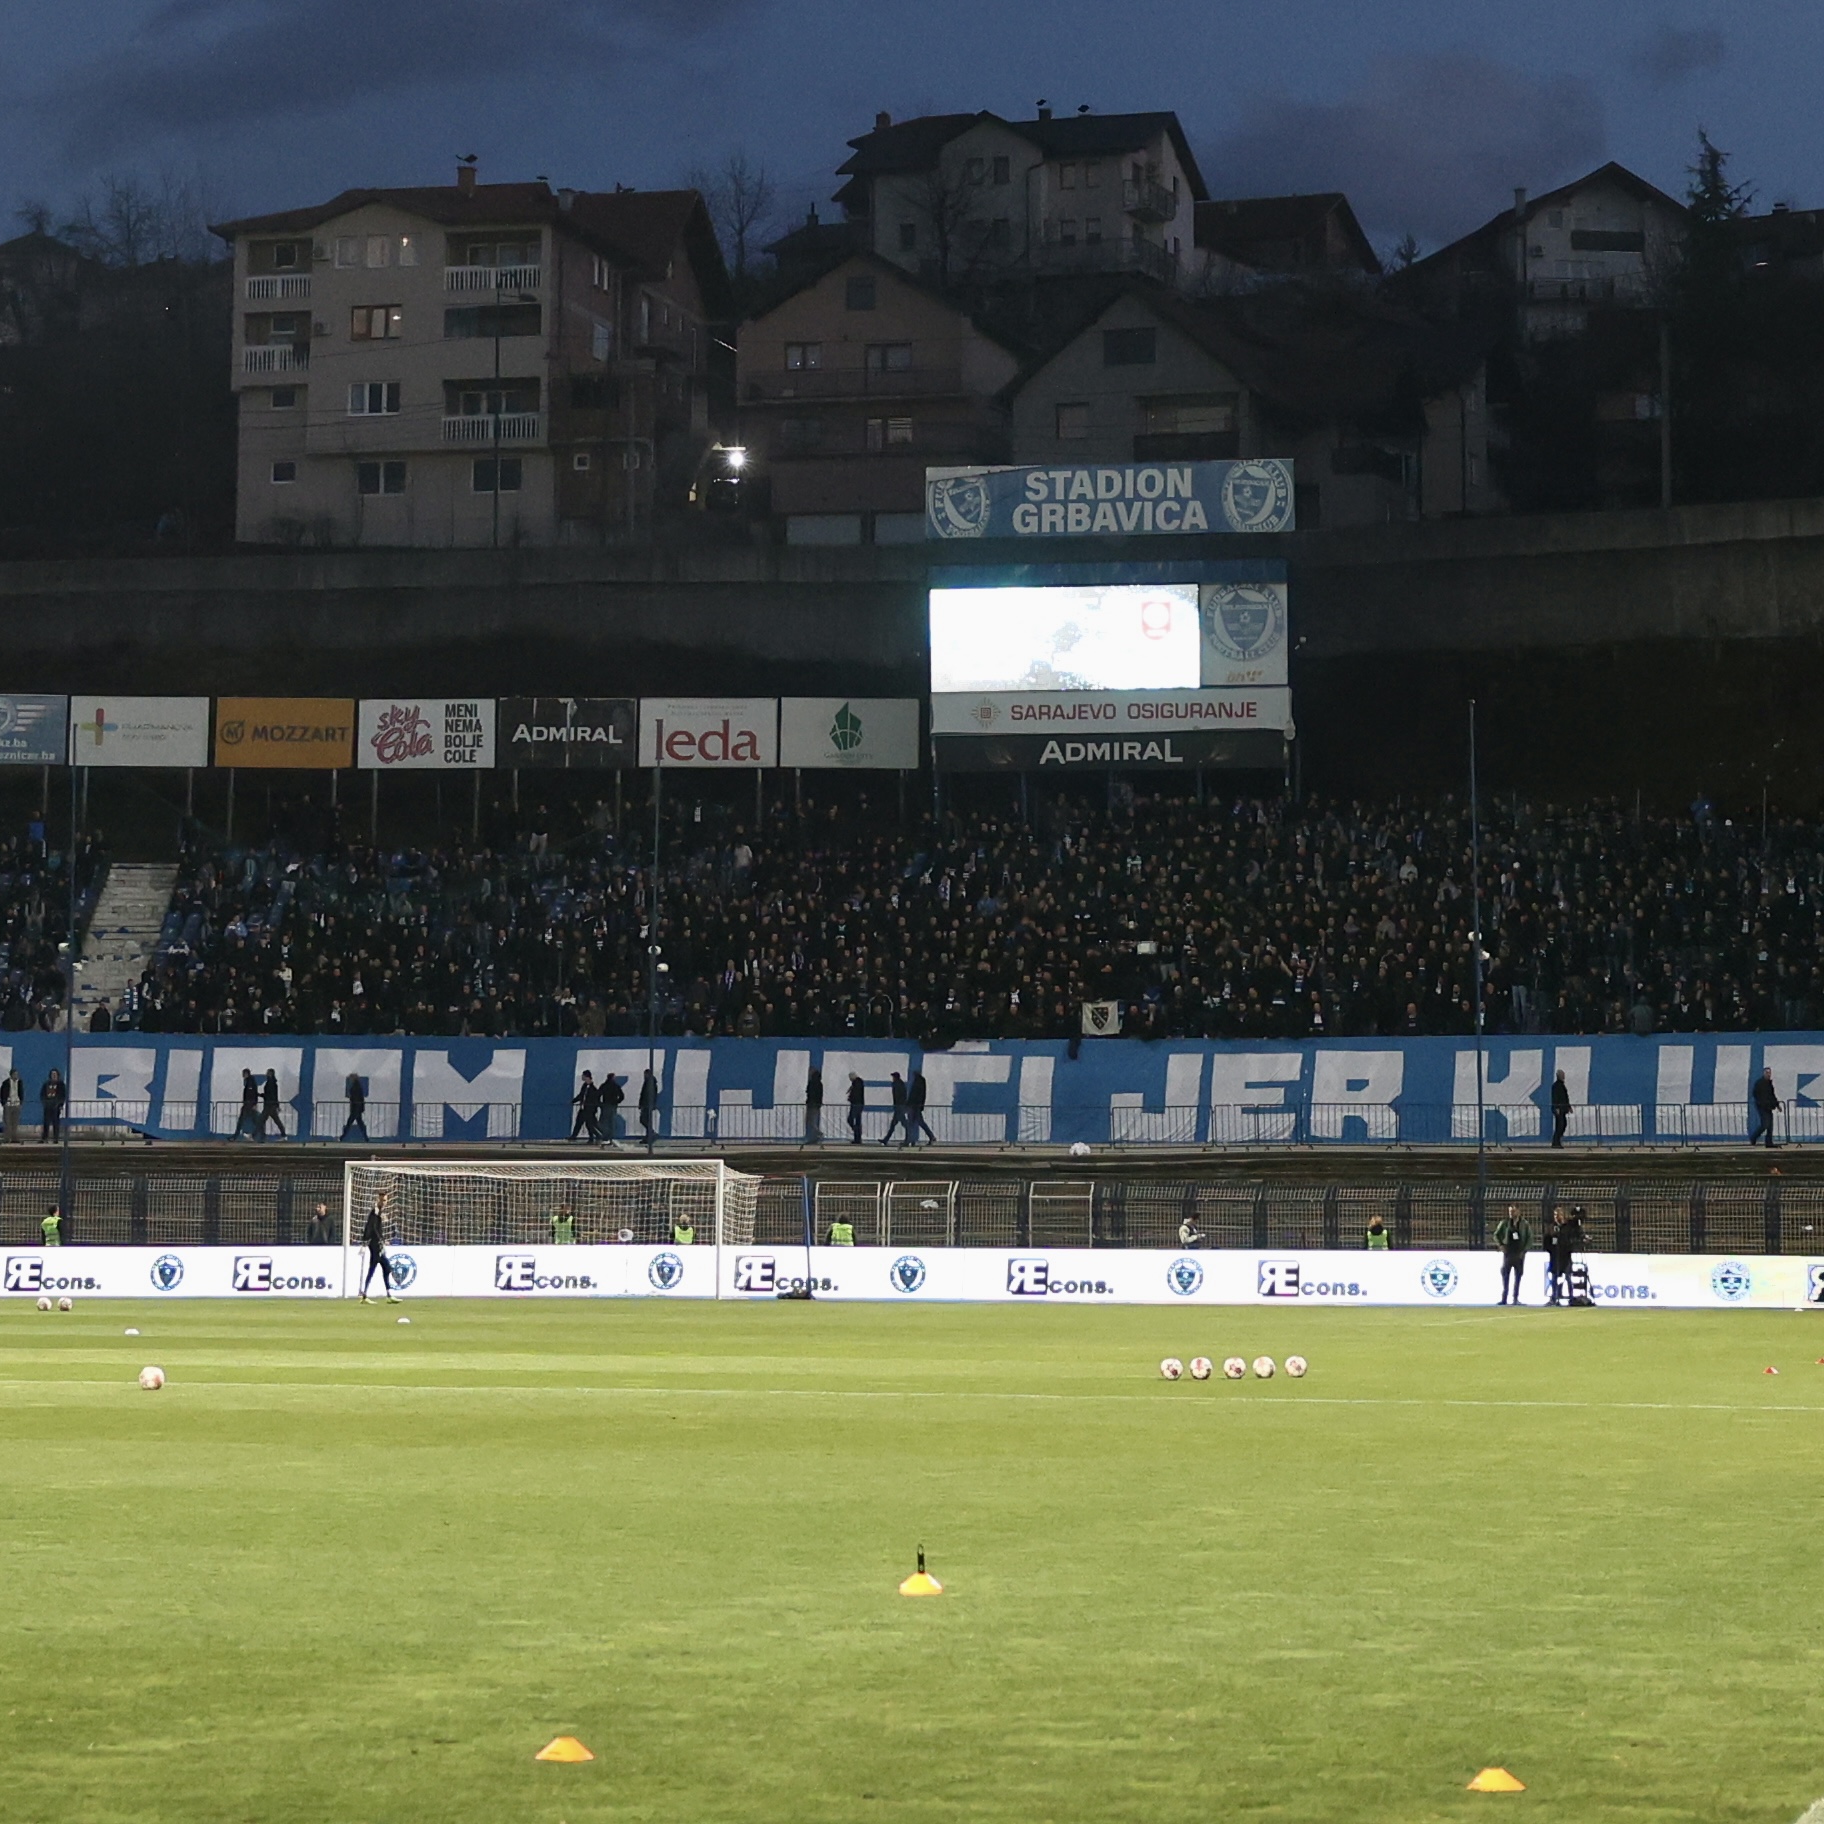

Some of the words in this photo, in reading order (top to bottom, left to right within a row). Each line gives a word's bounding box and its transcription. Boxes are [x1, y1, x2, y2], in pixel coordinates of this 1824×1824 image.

[1025, 468, 1193, 501] STADION
[1012, 500, 1208, 534] GRBAVICA
[377, 704, 431, 734] sky
[445, 704, 478, 718] MENI
[1011, 704, 1117, 721] SARAJEVO
[1127, 702, 1257, 719] OSIGURANJE
[251, 726, 350, 743] MOZZART
[445, 719, 483, 733] NEMA
[511, 723, 624, 744] ADMIRAL
[371, 727, 435, 765] Cola
[445, 734, 484, 748] BOLJE
[655, 718, 761, 761] leda
[1039, 738, 1183, 765] ADMIRAL
[444, 749, 477, 763] COLE
[68, 1047, 525, 1139] BIRAM
[1111, 1049, 1405, 1141] JER
